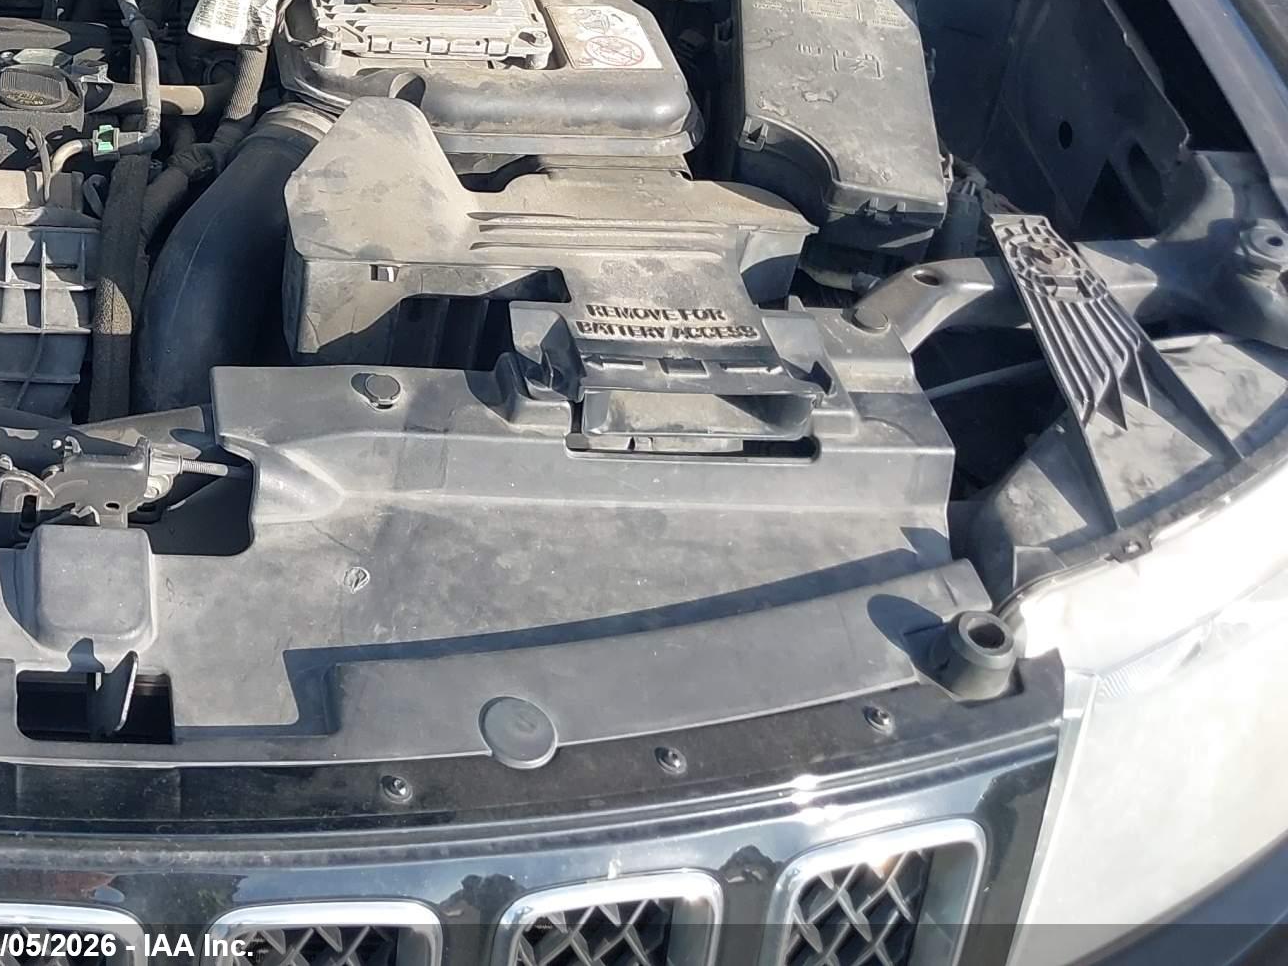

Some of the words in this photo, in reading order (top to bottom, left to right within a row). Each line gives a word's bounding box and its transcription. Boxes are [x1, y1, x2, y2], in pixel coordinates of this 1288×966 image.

[585, 304, 678, 321] REMOVE
[678, 307, 727, 322] FOR
[575, 320, 667, 339] BATTERY
[672, 325, 758, 340] ACCESS
